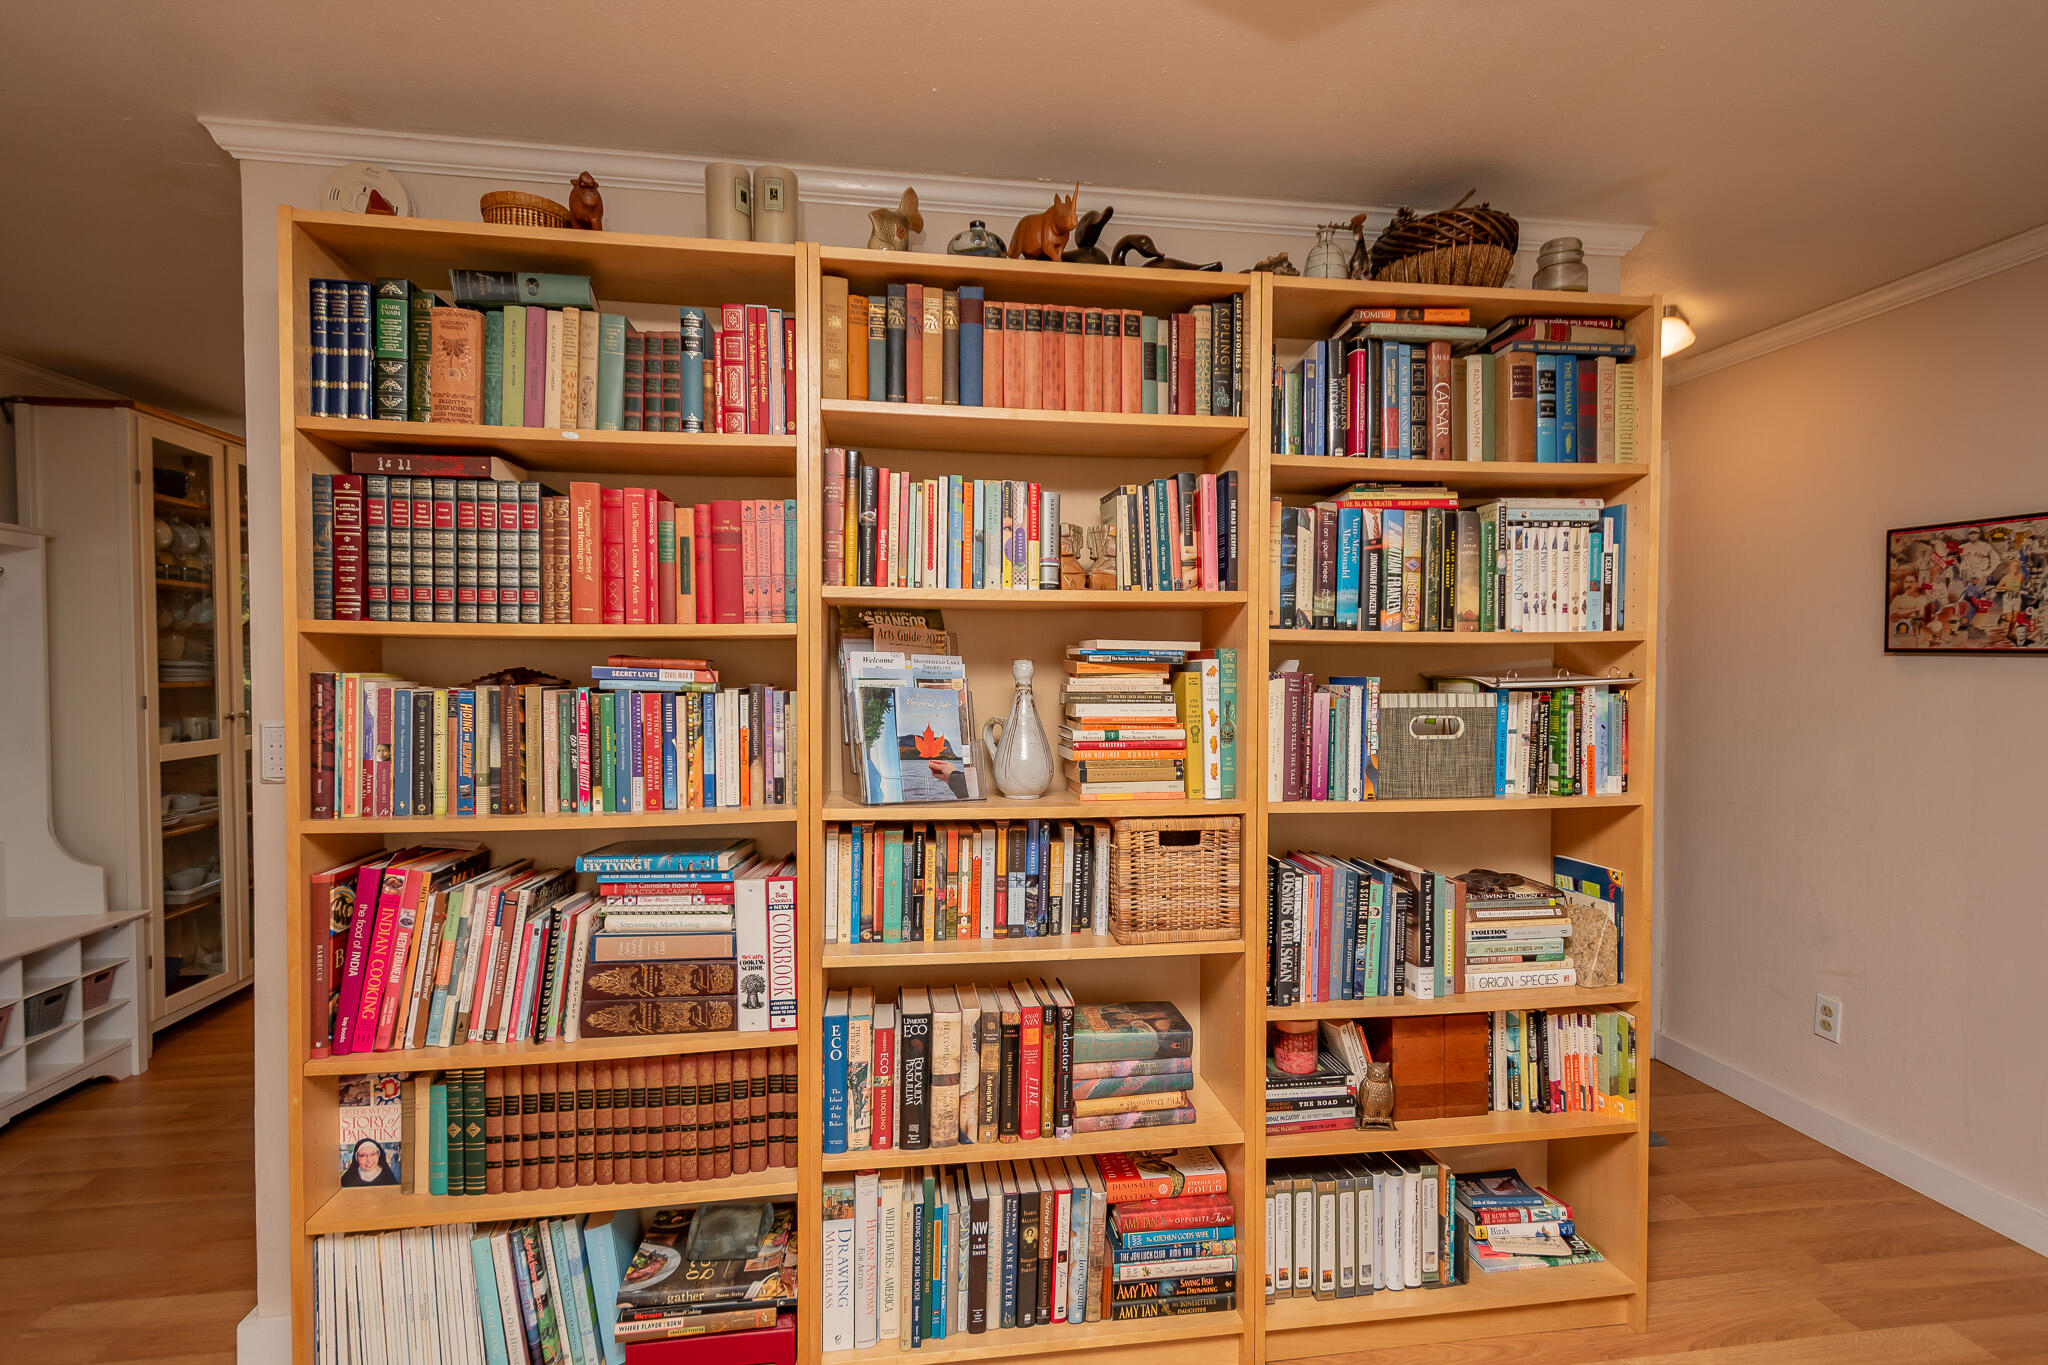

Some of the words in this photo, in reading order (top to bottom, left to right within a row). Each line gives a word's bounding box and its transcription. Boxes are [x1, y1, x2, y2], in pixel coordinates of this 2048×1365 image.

[748, 321, 756, 341] Alice's
[1220, 307, 1231, 366] KIPLING
[1235, 320, 1242, 334] SO
[1400, 363, 1409, 376] AS
[1563, 360, 1572, 379] THE
[1400, 376, 1409, 394] THE
[1472, 367, 1481, 405] ROMAN
[1603, 371, 1615, 394] BEN
[1432, 381, 1452, 438] CAESAR
[1563, 380, 1572, 416] ROMAN
[1400, 395, 1409, 431] ROMANS
[1602, 397, 1614, 425] HUR
[1400, 432, 1409, 447] DID
[1472, 409, 1481, 448] WOMEN
[631, 502, 639, 519] Little
[1185, 503, 1193, 537] Artemisia
[1322, 511, 1335, 525] fall
[631, 519, 639, 543] Women
[1322, 527, 1330, 538] on
[1351, 515, 1361, 564] Ann-Marie
[576, 530, 585, 574] Hemingway
[879, 528, 887, 561] Siegfried
[1321, 539, 1330, 559] your
[1341, 528, 1352, 579] MacDonald
[631, 548, 639, 569] Louisa
[1368, 552, 1378, 586] JONATHAN
[1540, 550, 1548, 573] PARIS
[1604, 555, 1612, 585] ICELAND
[630, 569, 639, 583] May
[1322, 560, 1333, 584] knees
[1514, 552, 1523, 601] POLAND
[1562, 555, 1570, 589] LONDON
[1368, 585, 1378, 615] FRANZEN
[873, 615, 928, 627] BANGOR
[877, 627, 896, 641] Arts
[896, 628, 921, 641] Guide
[862, 656, 895, 664] Welcome
[1291, 723, 1297, 733] TO
[852, 841, 860, 853] The
[583, 862, 603, 872] FLY
[603, 861, 642, 871] TYING
[1074, 853, 1082, 876] Freud's
[1280, 871, 1295, 915] COSMOS
[1346, 879, 1355, 904] FIRST
[1424, 878, 1432, 893] The
[358, 903, 369, 917] the
[1358, 888, 1369, 920] SCIENCE
[1424, 894, 1432, 922] Wisdom
[355, 918, 367, 939] food
[1345, 905, 1354, 930] EDEN
[1424, 923, 1432, 931] of
[373, 907, 396, 956] INDIAN
[1280, 919, 1294, 947] CARL
[1357, 923, 1367, 957] ODYSSEY
[352, 940, 363, 950] of
[771, 913, 793, 996] COOKBOOK
[1423, 945, 1431, 963] Body
[316, 944, 324, 983] BARBECUE
[348, 950, 362, 978] INDIA
[389, 931, 409, 984] MEDITERRANEAN
[739, 959, 766, 967] COOKING
[1279, 947, 1293, 983] SAGAN
[361, 958, 385, 1020] COOKING
[1478, 976, 1514, 989] ORIGIN
[1519, 973, 1560, 987] SPECIES
[903, 1024, 928, 1038] ECO
[1062, 1020, 1071, 1032] the
[880, 1052, 889, 1075] ECO
[1061, 1032, 1074, 1072] doctor
[913, 1056, 925, 1106] FOUCAULT'S
[985, 1074, 994, 1106] Antonio's
[1028, 1076, 1039, 1108] FIRE
[1316, 1098, 1339, 1106] ROAD
[341, 1115, 387, 1129] STORY
[385, 1113, 402, 1129] of
[985, 1106, 993, 1123] Wife
[1112, 1181, 1155, 1190] DINOSAUR
[1187, 1184, 1222, 1194] GOULD
[914, 1206, 922, 1238] CREATING
[1489, 1226, 1511, 1236] Birds
[865, 1218, 877, 1261] HUMAN
[885, 1207, 896, 1269] WILDFLOWERS
[1090, 1215, 1105, 1255] TISHA
[1152, 1233, 1177, 1243] KITCHEN
[1177, 1232, 1195, 1242] GOD'S
[1194, 1230, 1209, 1239] WIFE
[857, 1247, 865, 1262] FOR
[914, 1255, 921, 1265] SO
[1005, 1240, 1015, 1270] ANNE
[824, 1230, 836, 1310] MASTERCLASS
[837, 1227, 853, 1308] DRAWING
[857, 1263, 865, 1291] ARTISTS
[666, 1291, 705, 1304] gather
[865, 1261, 877, 1317] ANATOMY
[884, 1275, 895, 1313] AMERICA
[913, 1278, 921, 1301] HOUSE
[1004, 1274, 1013, 1307] TYLER
[1116, 1284, 1140, 1300] AMY
[1138, 1282, 1158, 1299] TAN
[503, 1295, 513, 1317] NEW
[1119, 1304, 1142, 1320] AMY
[1140, 1303, 1158, 1317] TAN
[506, 1317, 516, 1336] OLD
[618, 1323, 640, 1332] WHERE
